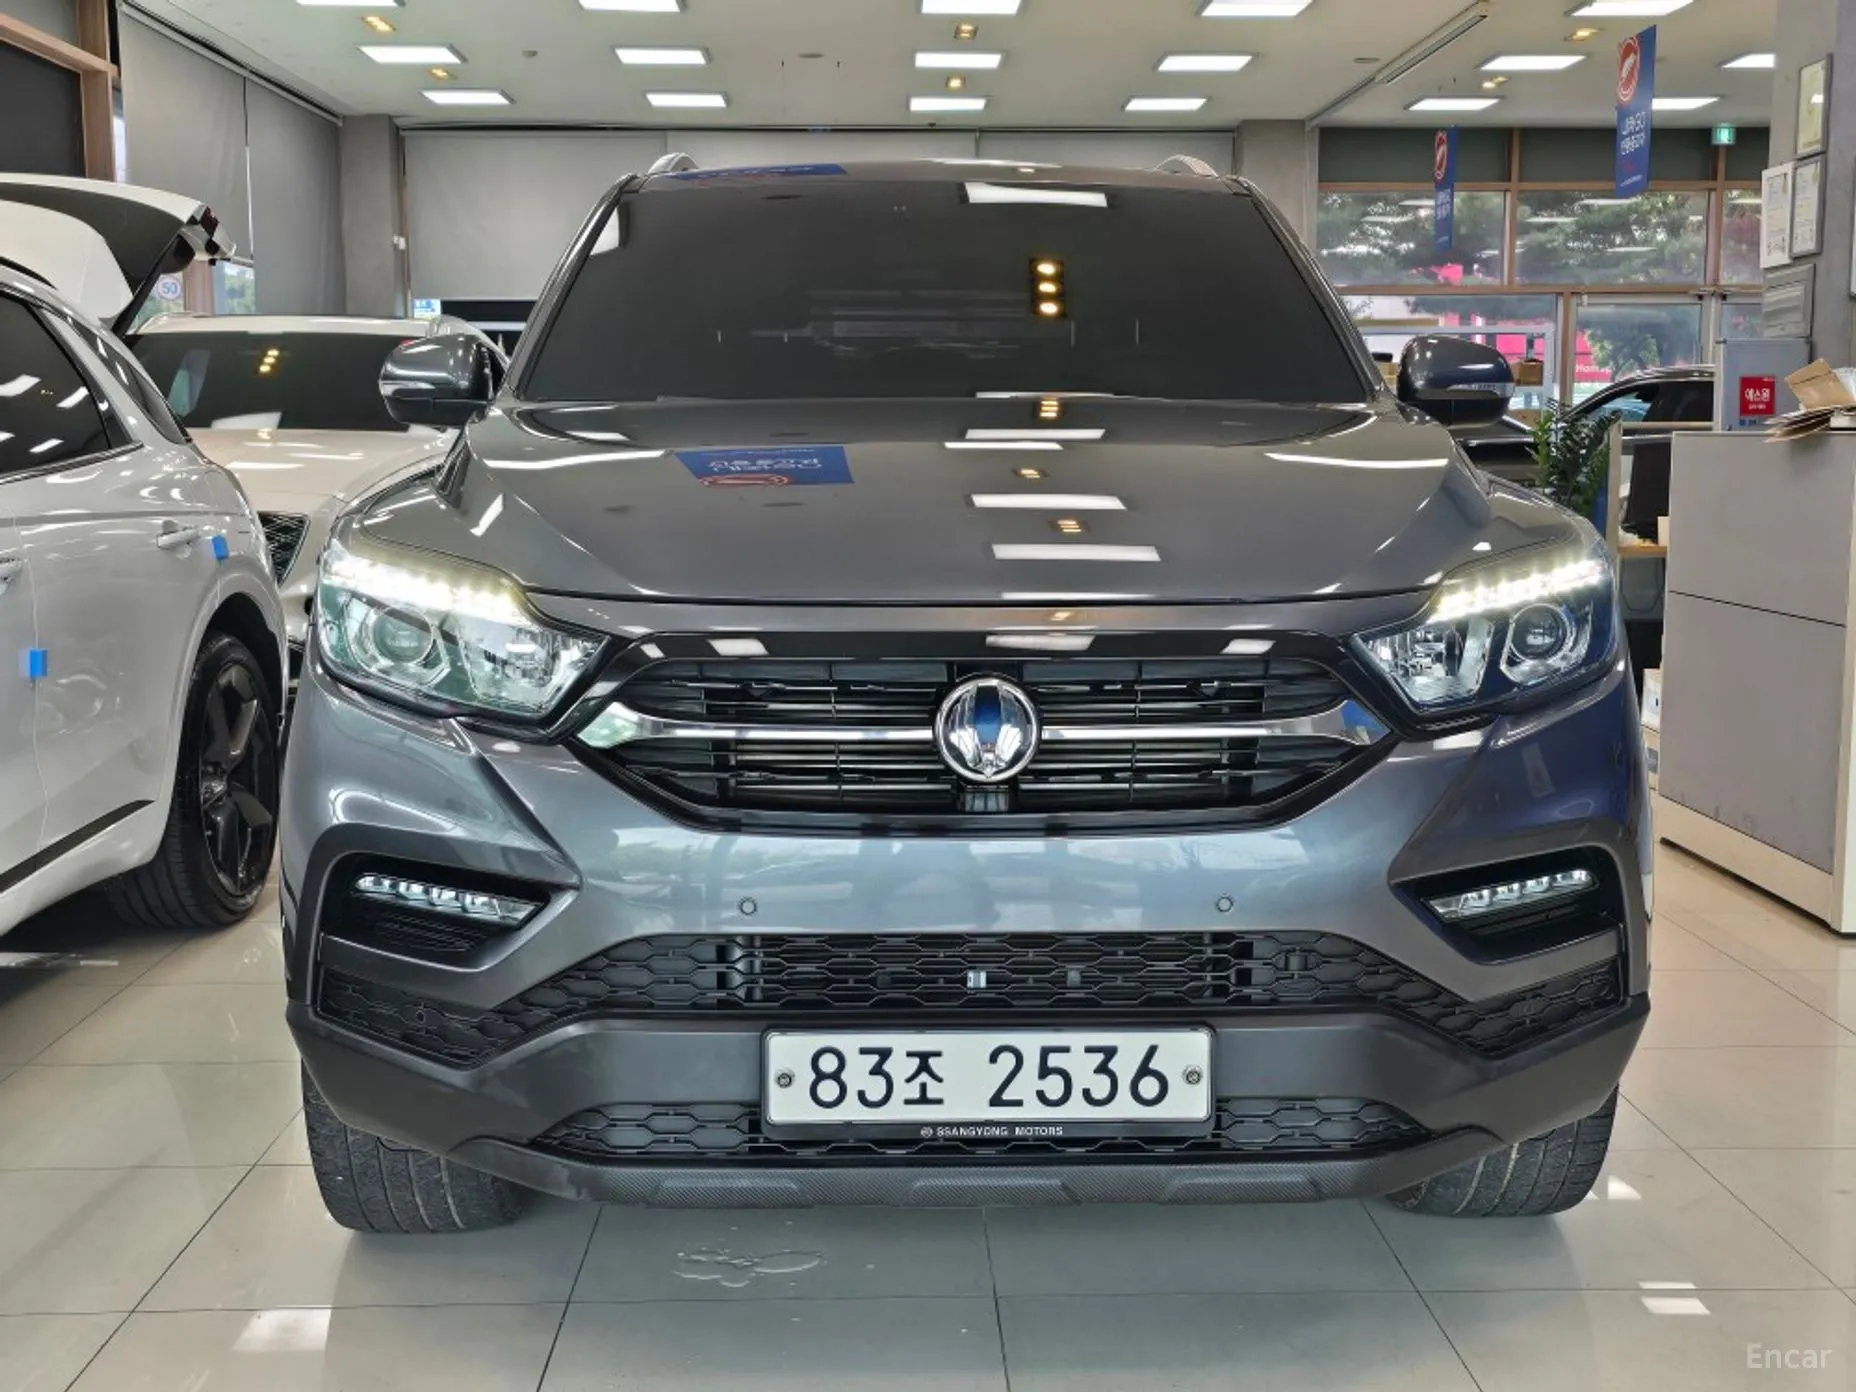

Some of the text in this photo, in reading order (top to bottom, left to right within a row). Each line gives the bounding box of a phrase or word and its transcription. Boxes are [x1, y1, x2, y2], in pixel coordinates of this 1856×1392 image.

[809, 1044, 1169, 1109] 83조 2536
[936, 1126, 1063, 1137] SSANGYONG MOTORS
